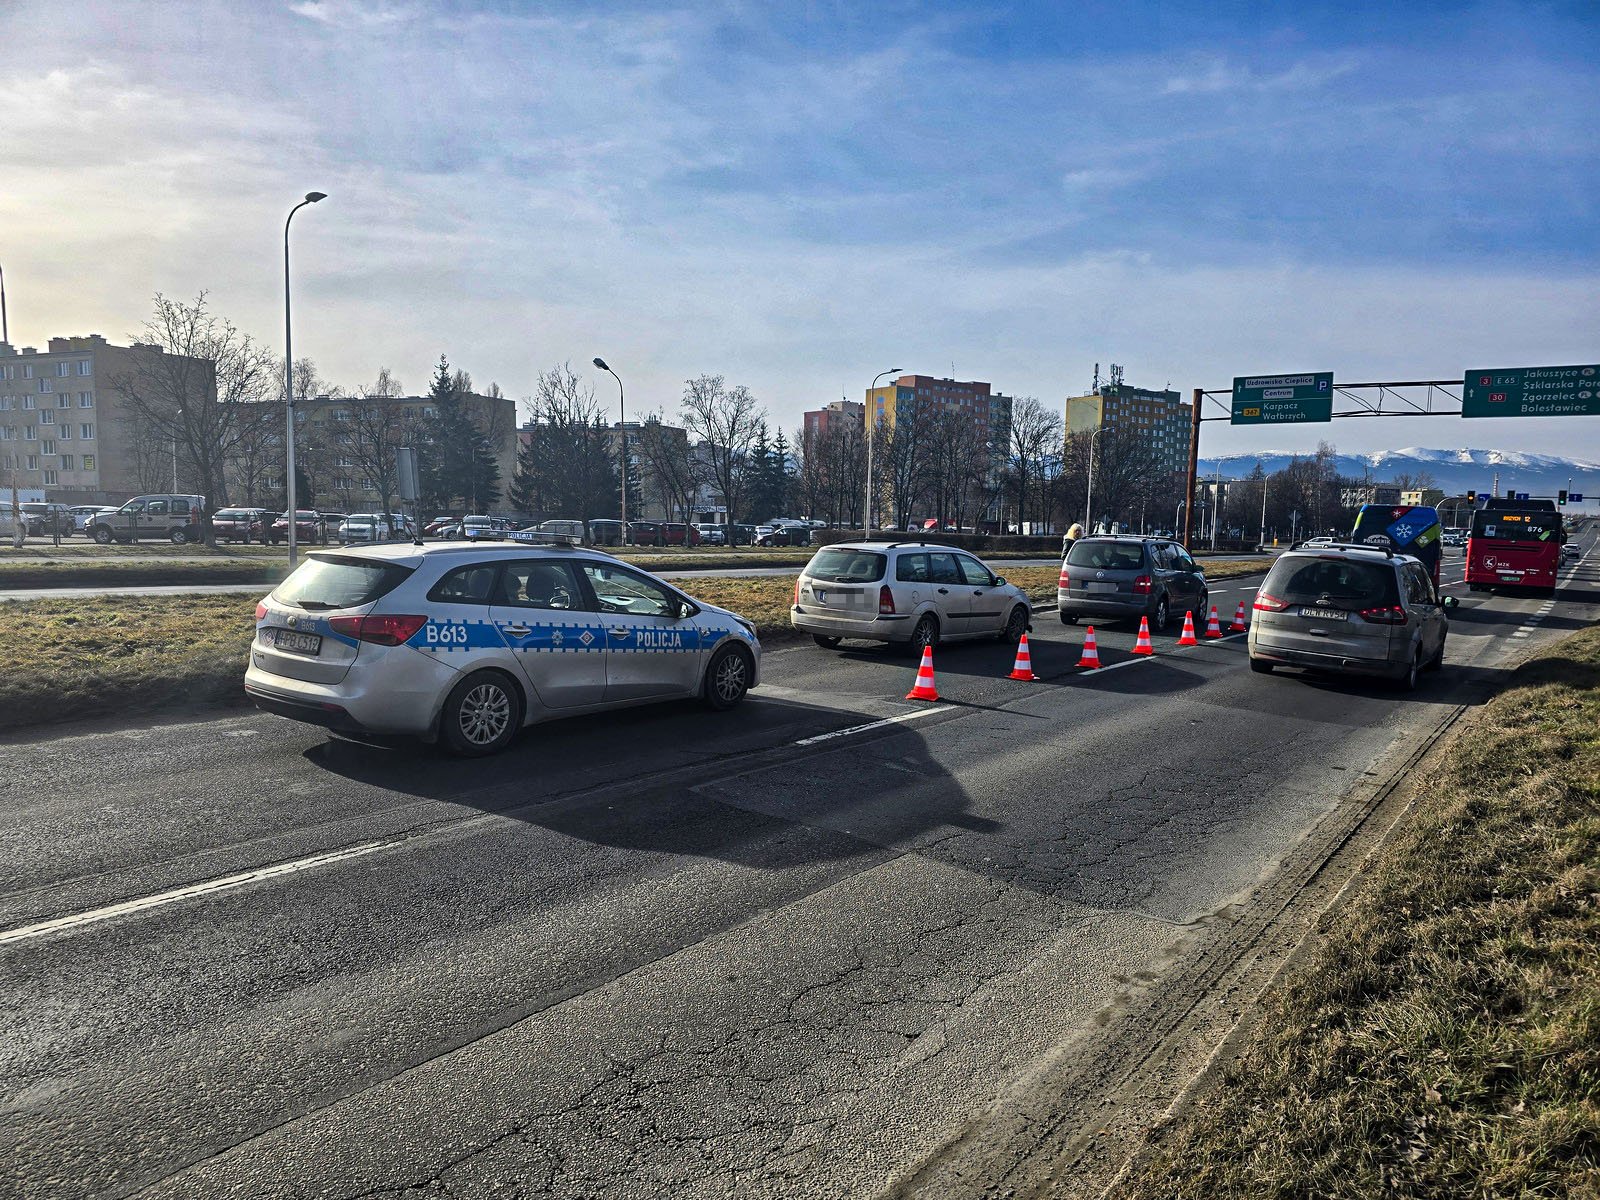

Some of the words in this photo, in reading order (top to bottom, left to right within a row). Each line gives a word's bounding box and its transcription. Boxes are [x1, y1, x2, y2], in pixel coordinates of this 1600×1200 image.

[1523, 370, 1578, 379] Jakuszyce
[1285, 377, 1312, 385] Cieplice
[1523, 381, 1574, 390] Szklarska
[1522, 392, 1575, 403] Zgorzelec
[1263, 402, 1298, 411] Karpacz
[1521, 403, 1587, 412] Bolesławiec
[1262, 412, 1306, 421] Wałbrzych
[301, 620, 316, 631] B613
[426, 625, 468, 643] B613
[636, 631, 683, 648] POLICJA
